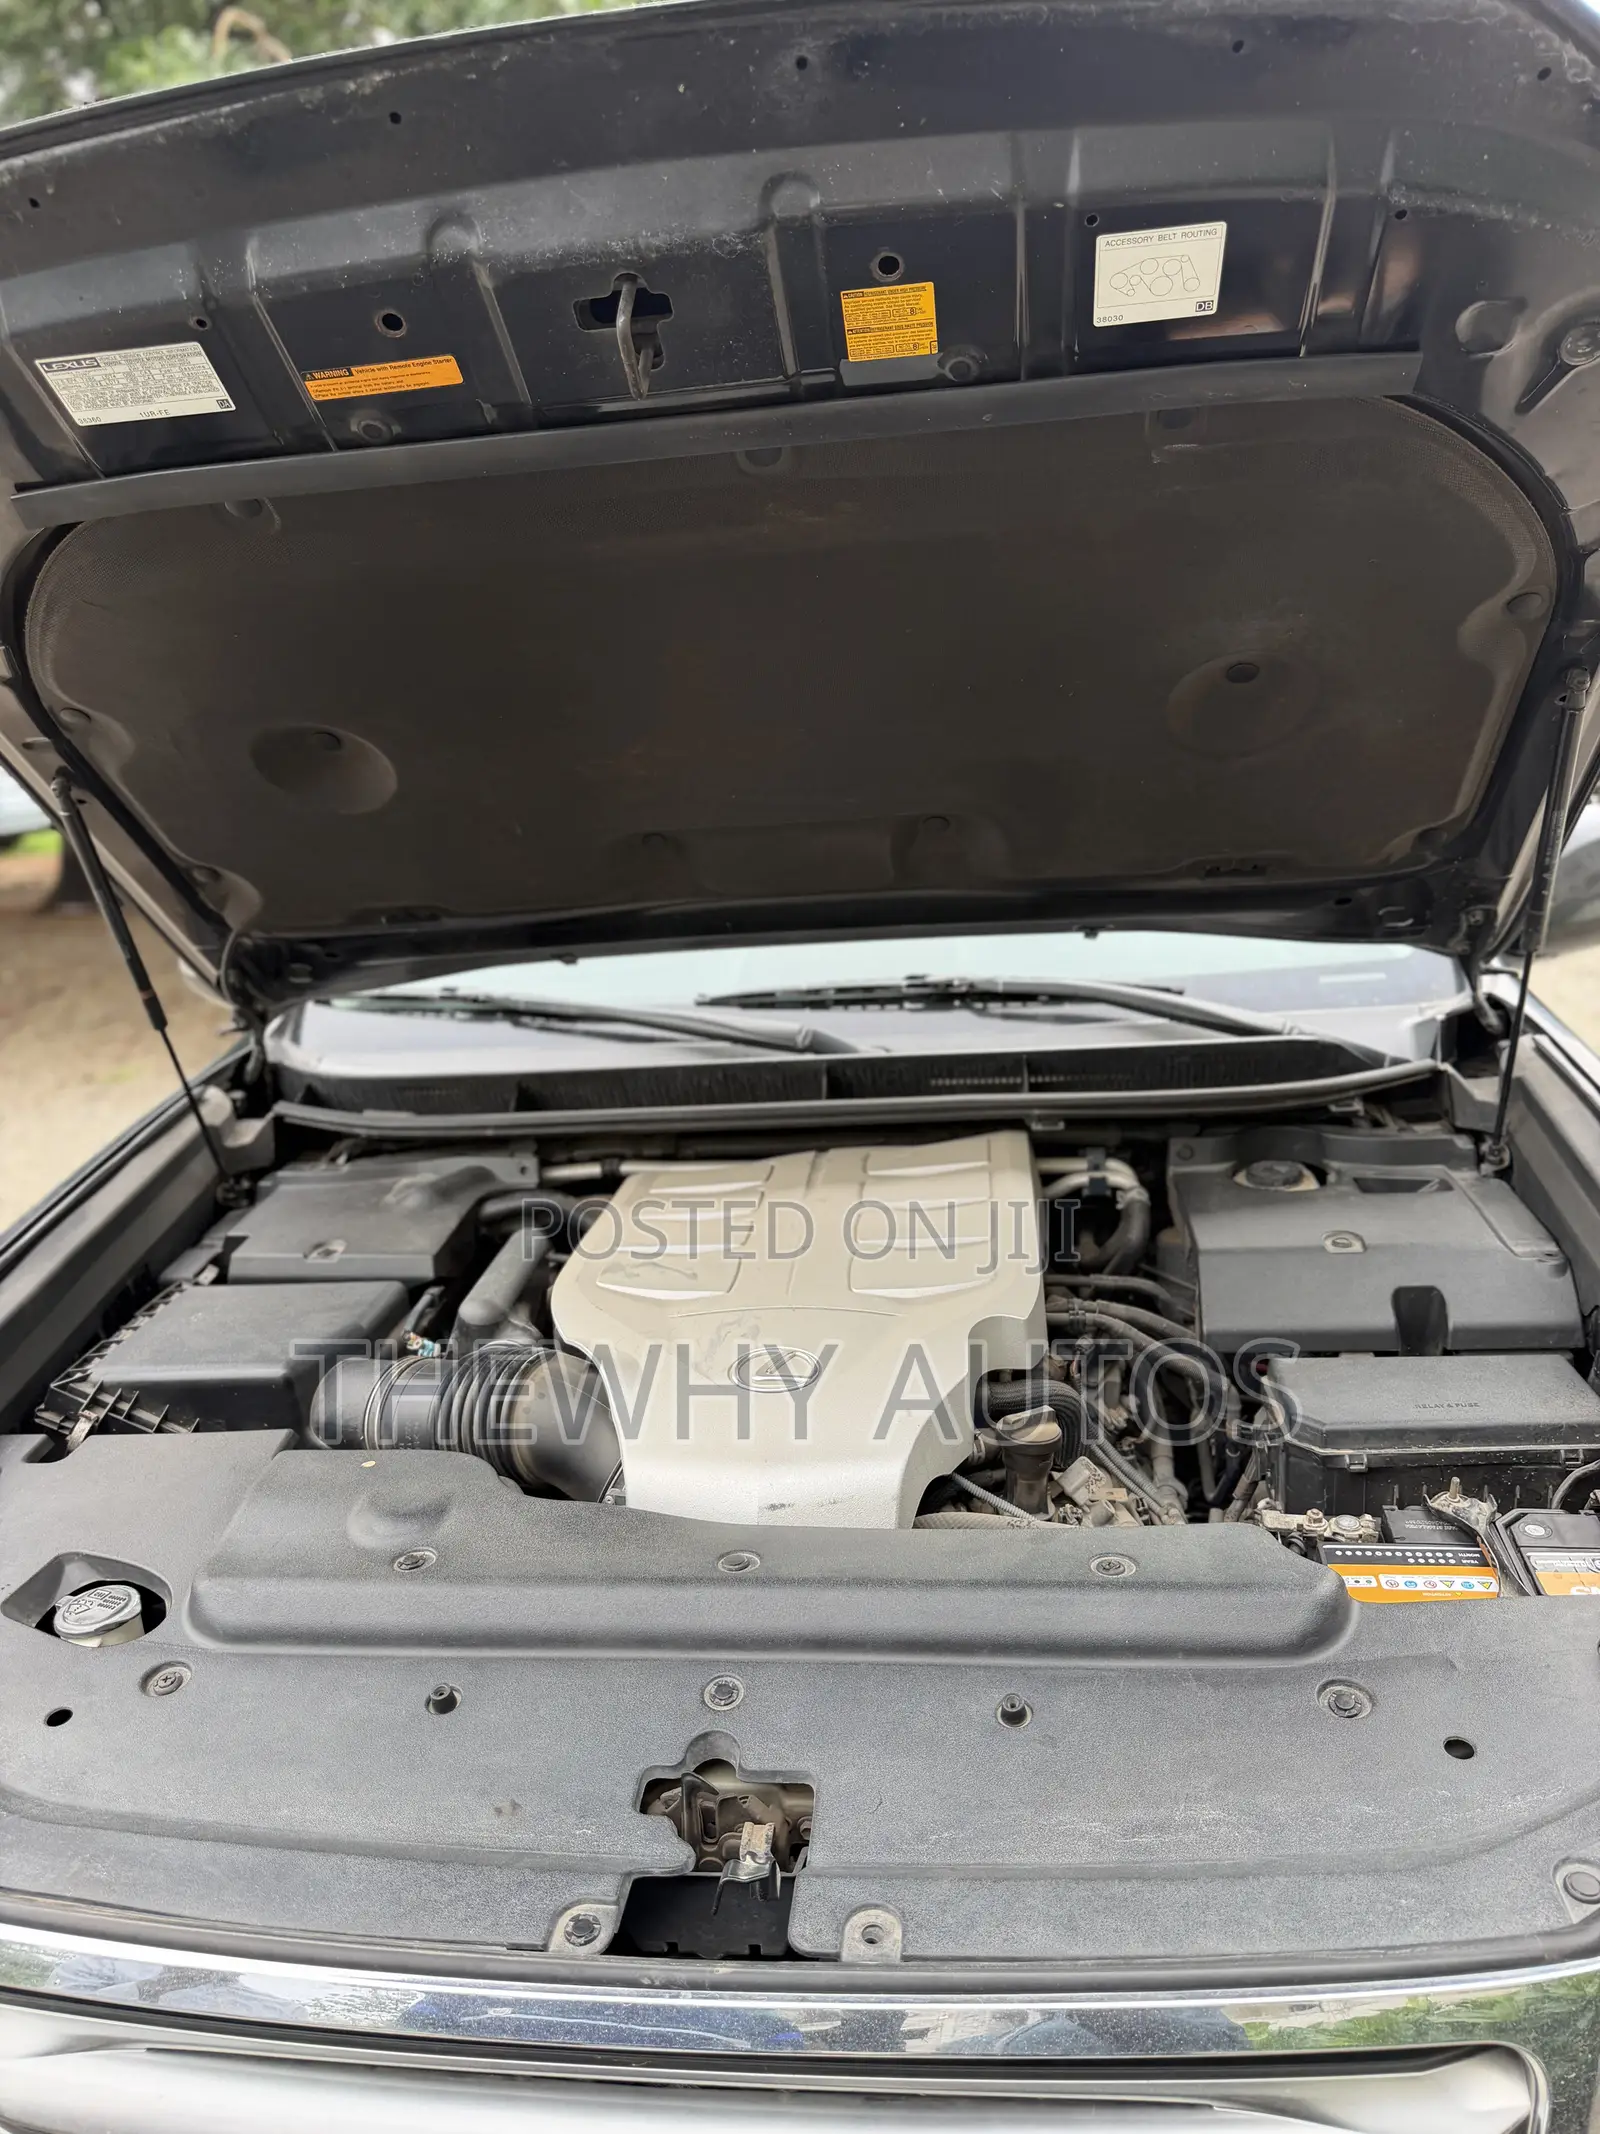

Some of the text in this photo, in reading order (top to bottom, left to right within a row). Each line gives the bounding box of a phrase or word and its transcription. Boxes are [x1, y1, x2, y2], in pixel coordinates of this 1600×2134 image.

[1105, 228, 1217, 247] ACCESSORY BELT ROUTING
[1195, 301, 1213, 311] DB
[1096, 314, 1124, 324] 38030
[42, 359, 98, 372] LEXUS
[313, 369, 349, 379] WARNING
[217, 400, 231, 409] DA
[140, 409, 170, 418] 1UR-FE
